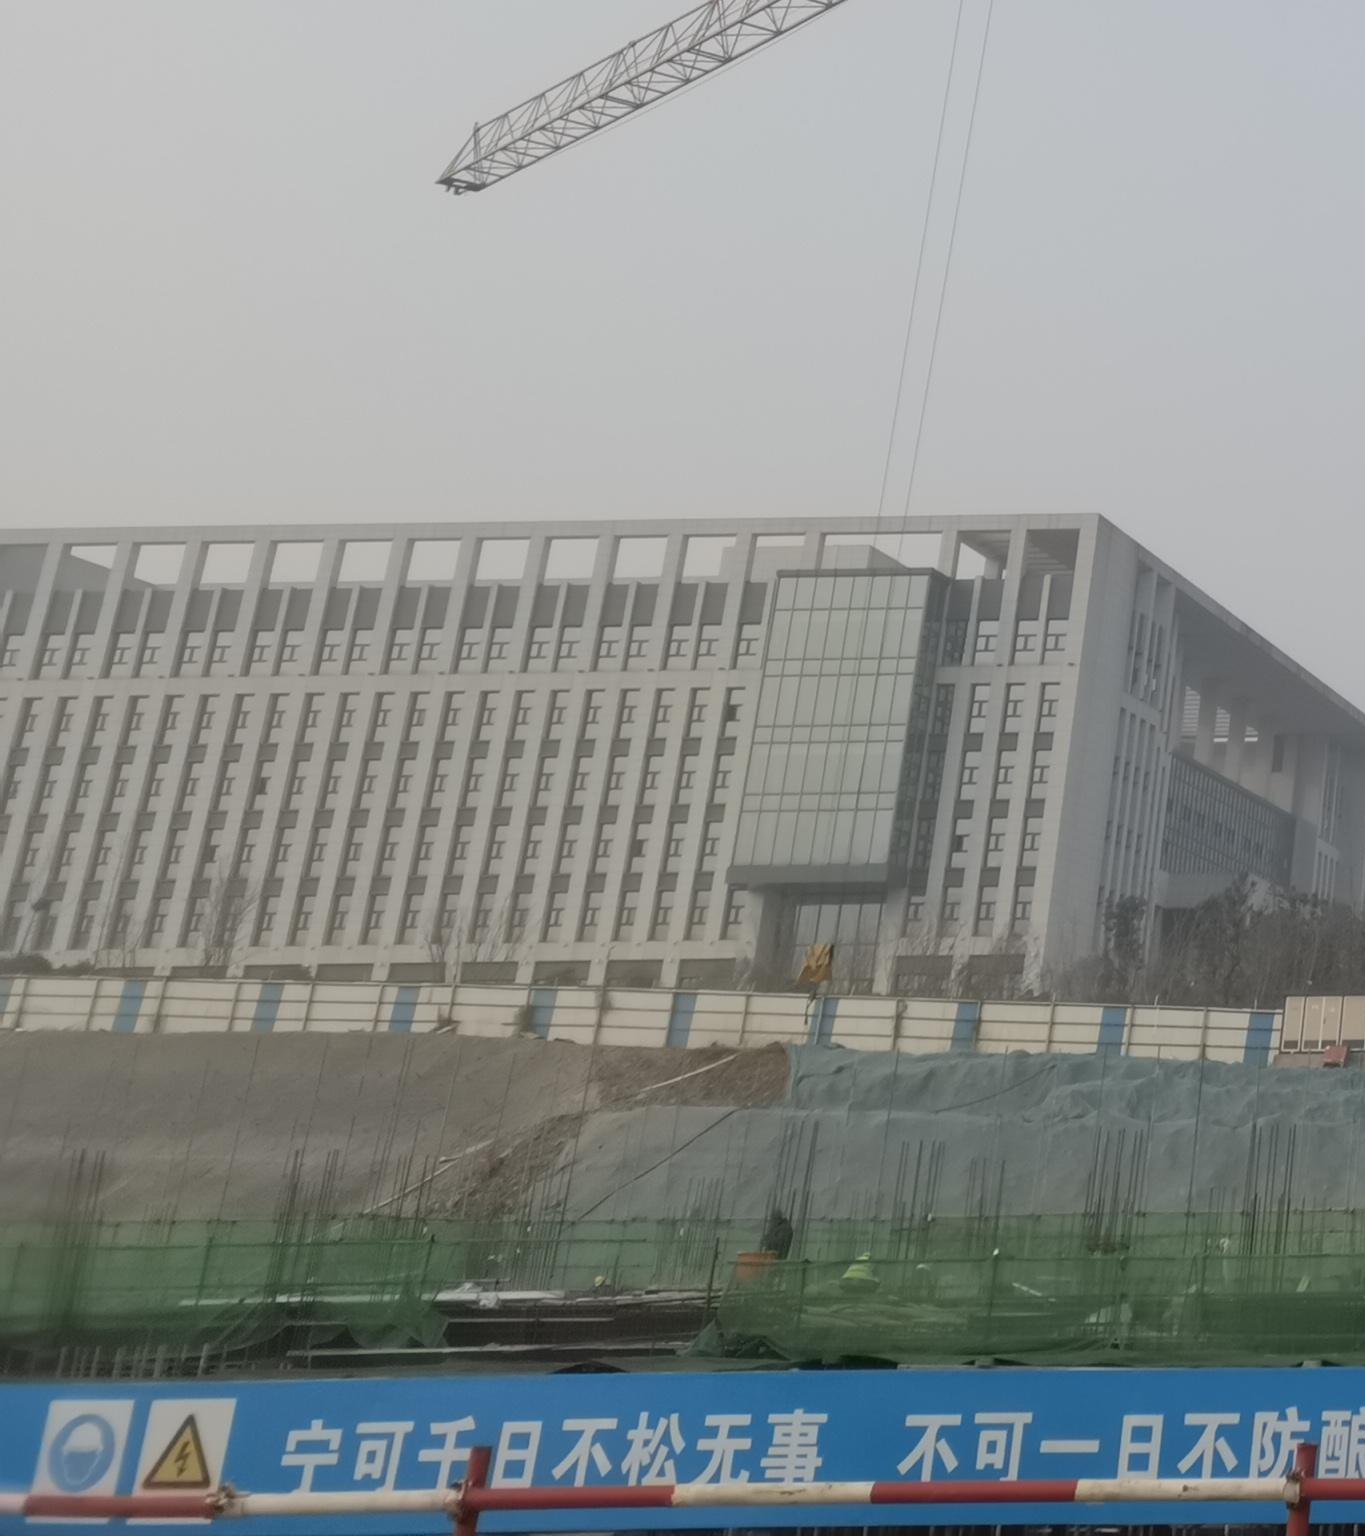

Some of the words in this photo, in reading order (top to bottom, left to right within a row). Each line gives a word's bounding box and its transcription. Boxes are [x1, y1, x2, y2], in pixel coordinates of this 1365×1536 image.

[280, 1408, 829, 1494] 宁可千日不松无事
